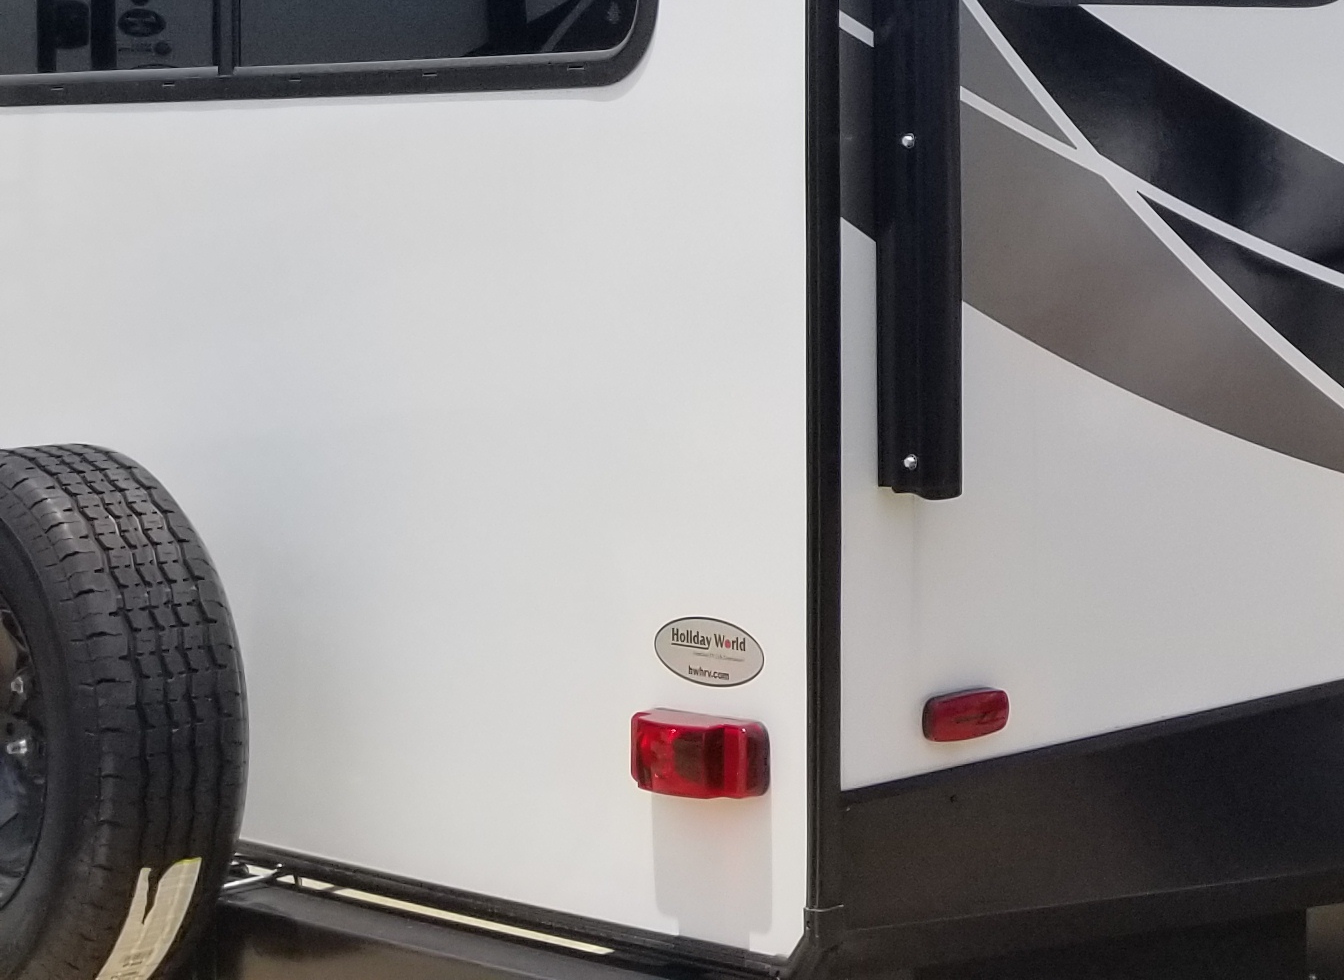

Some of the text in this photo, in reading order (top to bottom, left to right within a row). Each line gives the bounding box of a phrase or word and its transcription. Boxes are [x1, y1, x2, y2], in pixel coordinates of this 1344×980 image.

[671, 627, 746, 652] Holiday World
[688, 665, 729, 680] hwhrv.com
